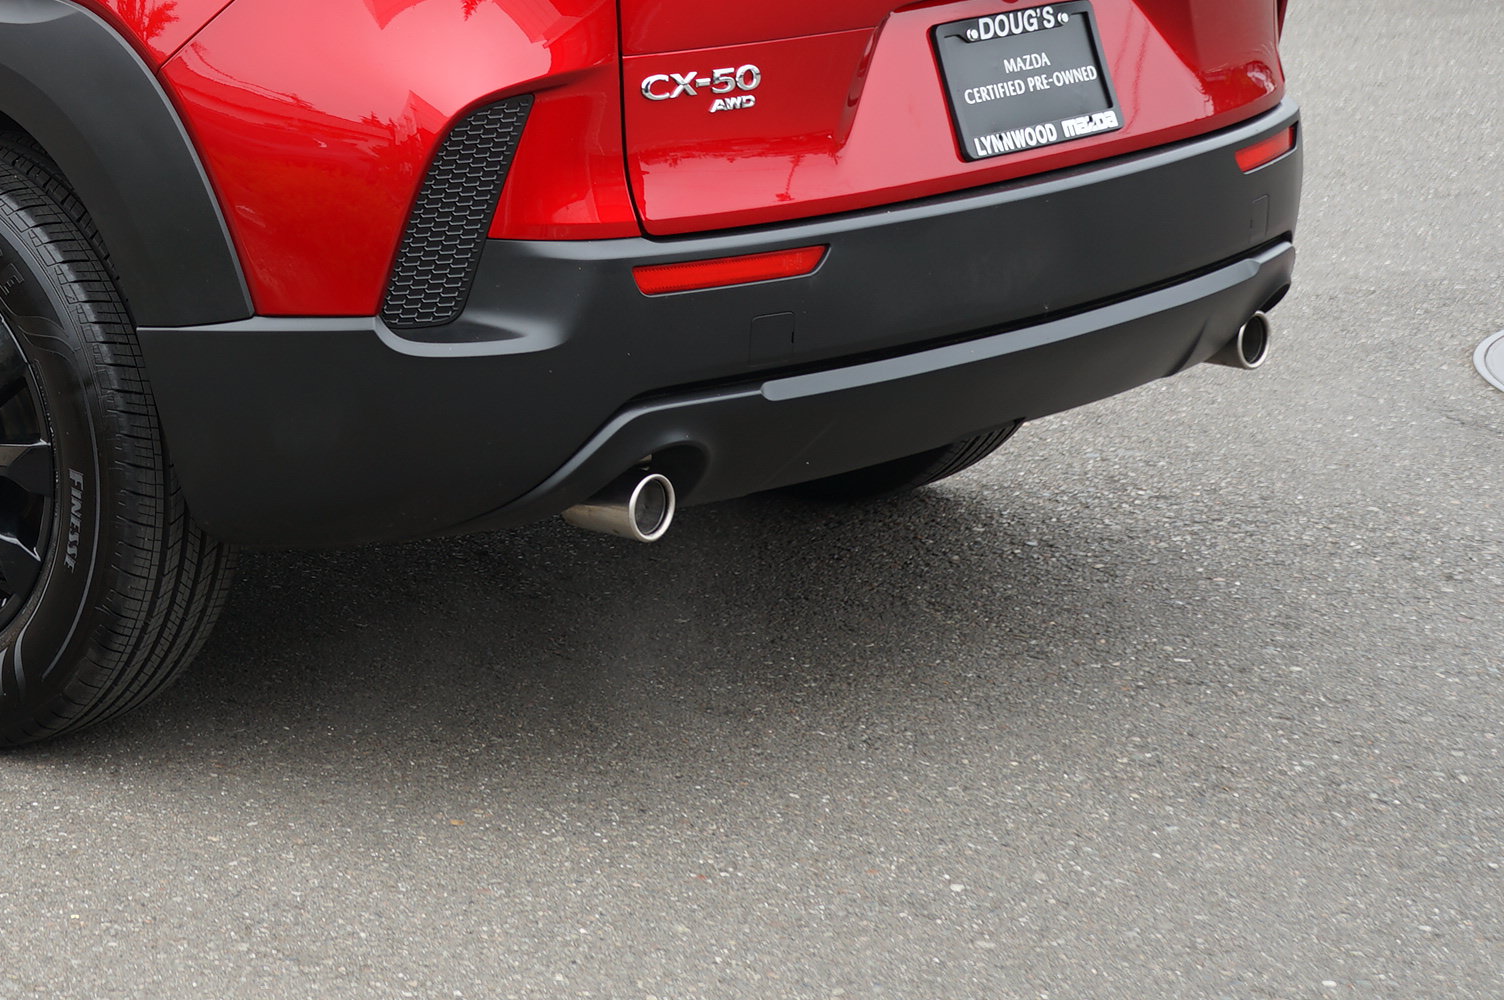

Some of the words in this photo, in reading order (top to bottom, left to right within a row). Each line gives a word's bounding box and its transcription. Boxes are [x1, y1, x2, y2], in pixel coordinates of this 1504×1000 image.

[978, 6, 1056, 40] DOUG'S
[1003, 52, 1051, 74] MAZDA
[641, 64, 762, 101] CX-50
[964, 80, 1026, 105] CERTIFIED
[1027, 65, 1098, 92] PRE-OWNED
[709, 94, 756, 113] AWD
[973, 123, 1058, 156] LYNNWOOD
[63, 467, 85, 574] FINESSE
